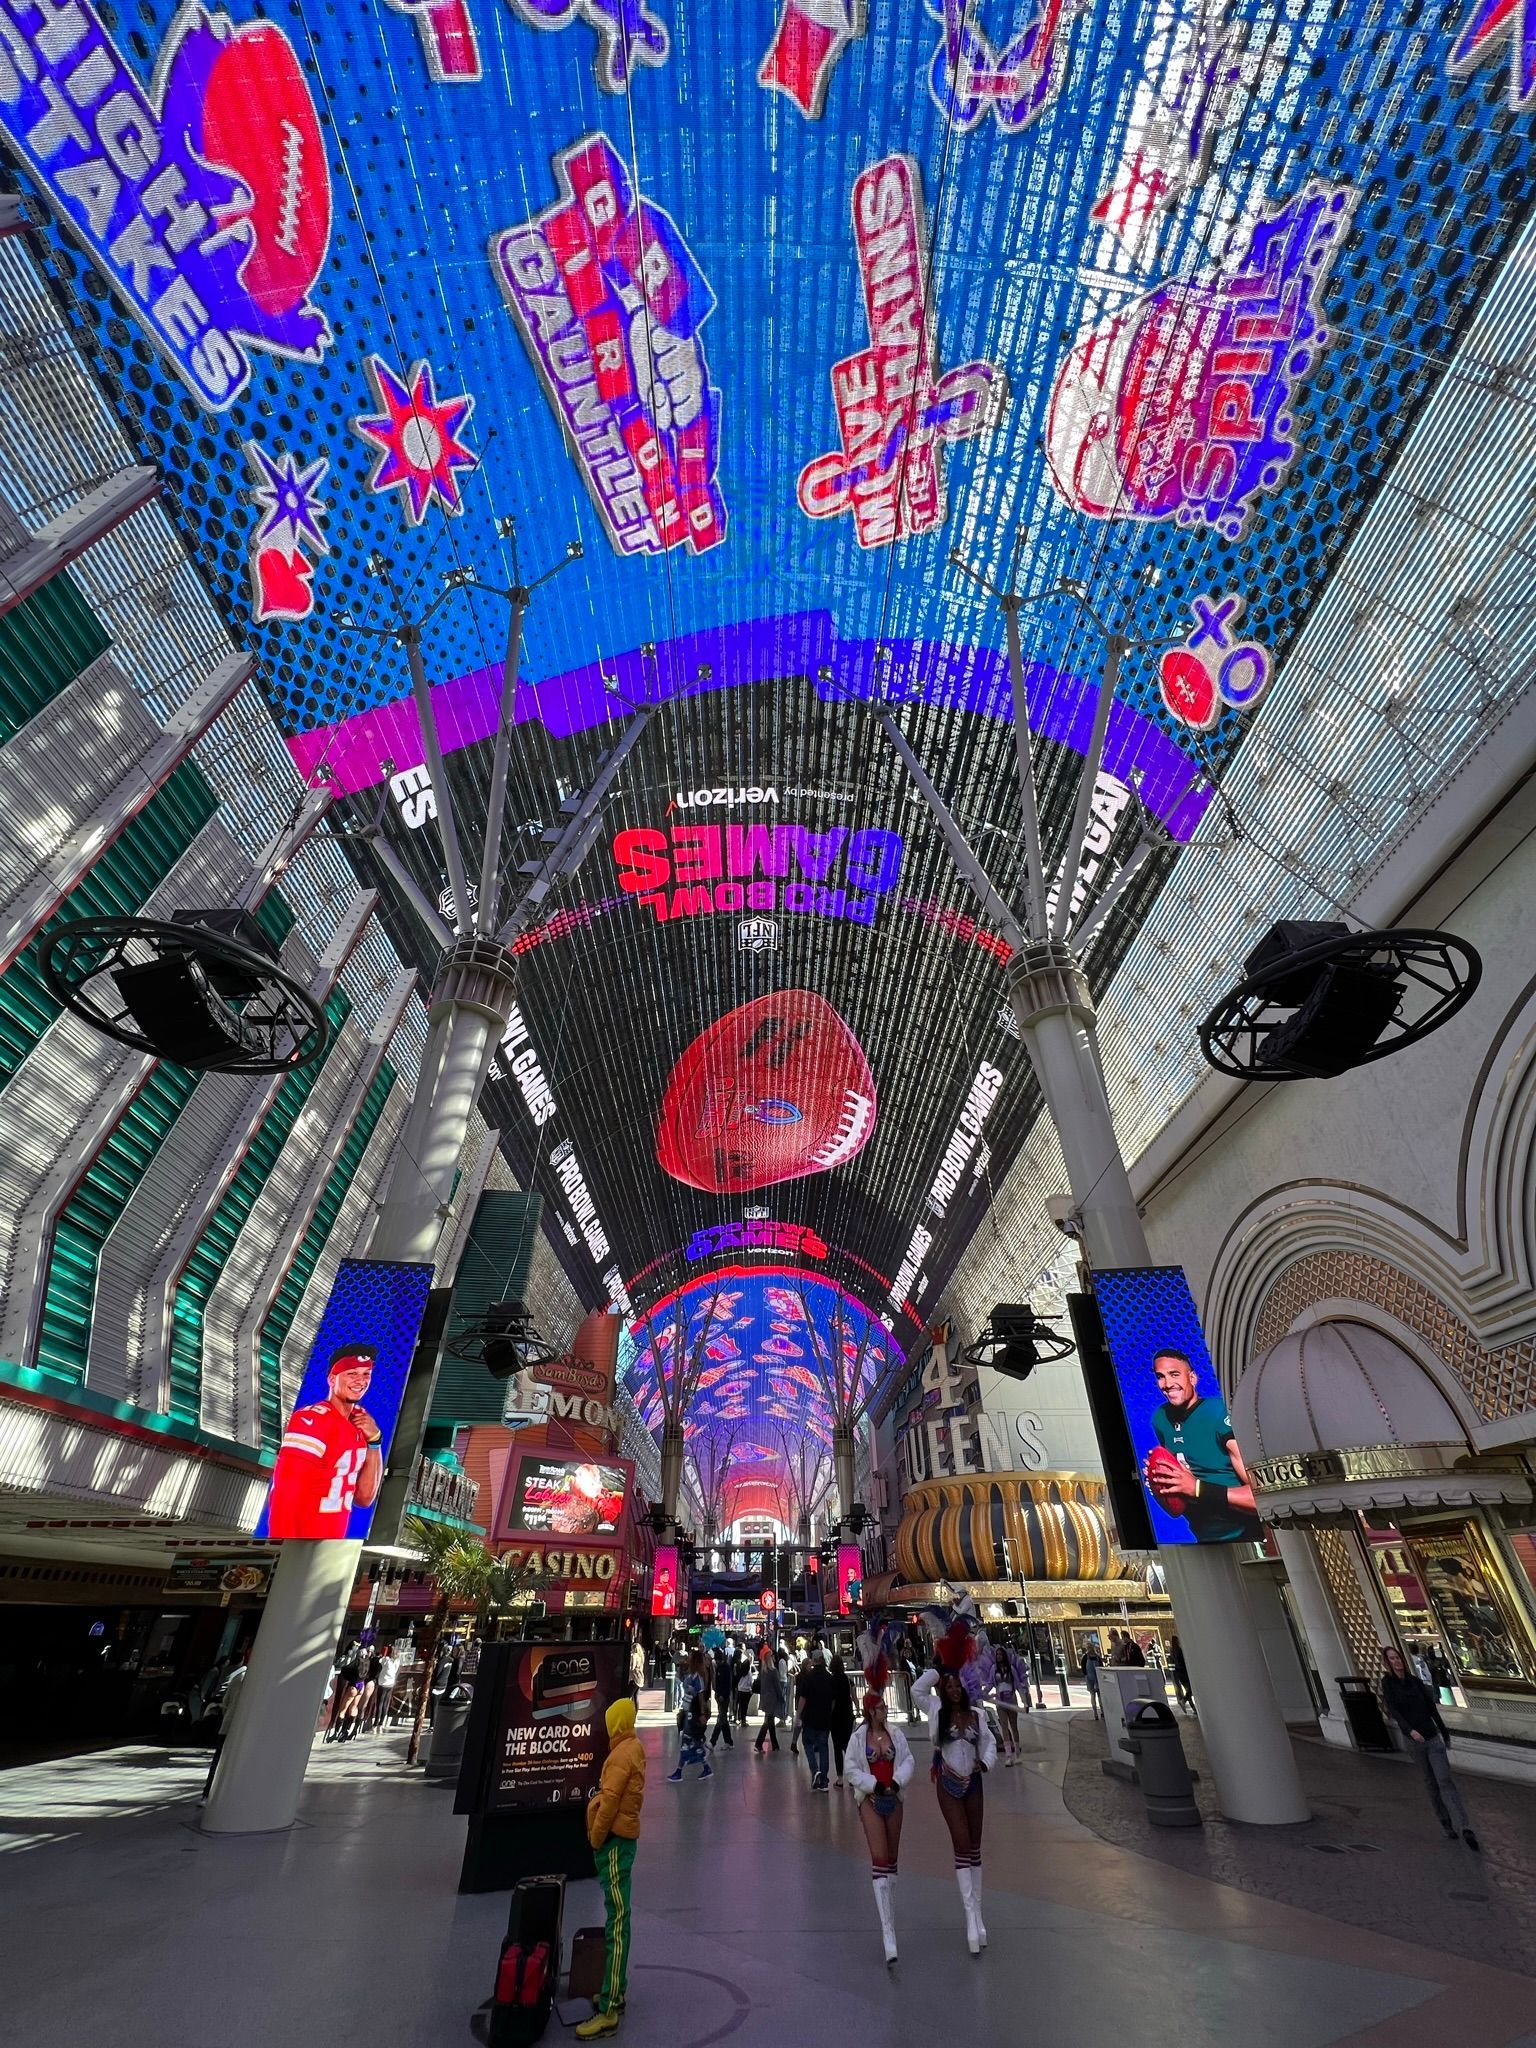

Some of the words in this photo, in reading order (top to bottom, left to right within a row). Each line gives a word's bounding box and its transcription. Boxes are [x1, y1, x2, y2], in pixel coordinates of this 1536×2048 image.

[10, 0, 209, 258] HIGH
[1188, 240, 1309, 500] SPILL
[510, 231, 663, 552] GAUNTLET
[677, 787, 779, 809] verizon
[784, 787, 798, 800] by
[800, 789, 855, 803] presented
[612, 824, 902, 894] GAMES
[639, 881, 776, 923] BOWL
[785, 882, 876, 926] PRO
[741, 922, 774, 938] NFL
[511, 1048, 556, 1126] GAMES
[941, 1128, 976, 1180] BOWL
[960, 1060, 1004, 1136] GAMES
[556, 1153, 582, 1194] PRO
[568, 1183, 596, 1231] BOWL
[584, 1219, 610, 1264] GAMES
[692, 1222, 743, 1242] PRO
[747, 1221, 821, 1241] BOWL
[686, 1232, 828, 1261] GAMES
[746, 1248, 794, 1257] verizon
[537, 1366, 566, 1381] Sam
[921, 1344, 964, 1409] 4
[525, 1476, 561, 1489] STEAK
[563, 1482, 570, 1491] &
[1252, 1459, 1334, 1487] NUGGET
[501, 1549, 616, 1580] CASINO
[557, 1658, 590, 1674] one
[506, 1727, 537, 1742] NEW
[538, 1725, 570, 1740] CARD
[571, 1724, 591, 1738] ON
[505, 1742, 527, 1756] THE
[529, 1739, 571, 1755] BLOCK.
[578, 1752, 594, 1761] $400
[553, 1790, 560, 1802] D
